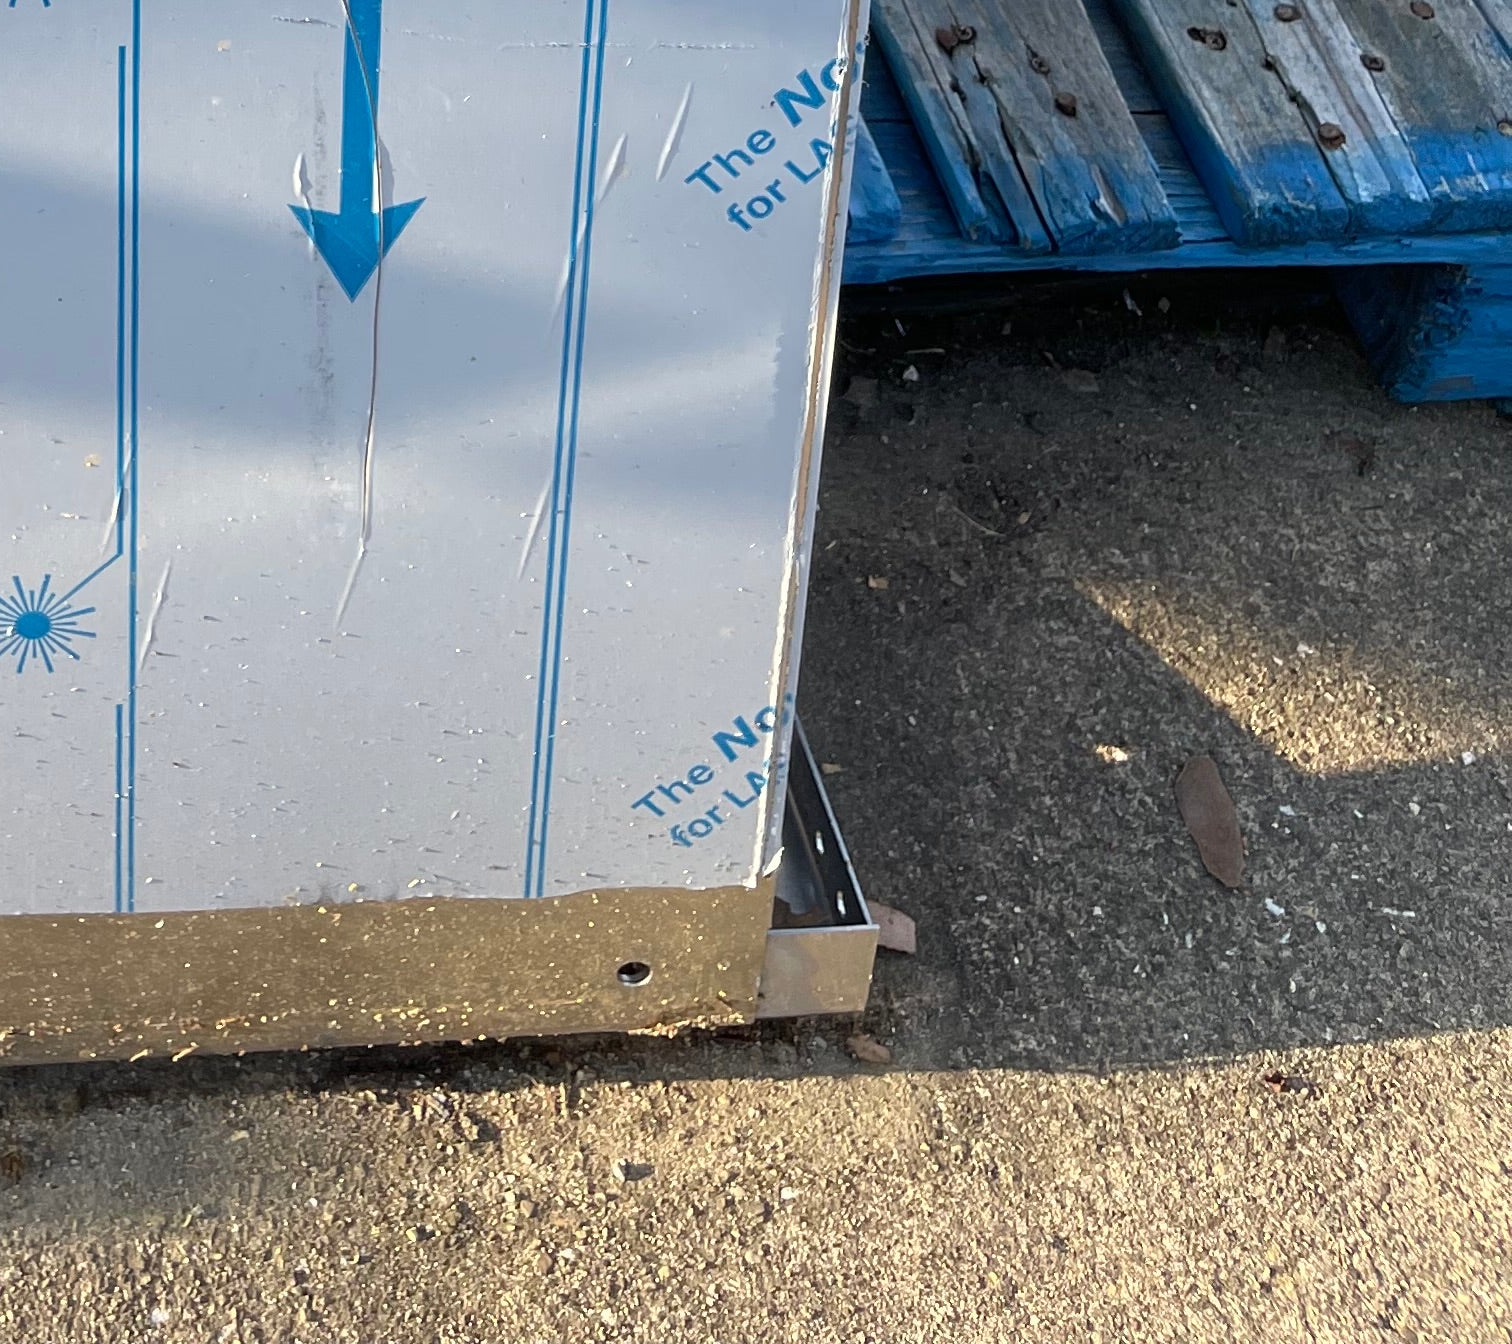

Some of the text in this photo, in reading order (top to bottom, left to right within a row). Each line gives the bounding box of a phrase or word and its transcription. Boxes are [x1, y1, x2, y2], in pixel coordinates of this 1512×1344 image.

[684, 129, 777, 193] The
[726, 179, 786, 232] for
[630, 764, 714, 817] The
[668, 806, 724, 849] for
